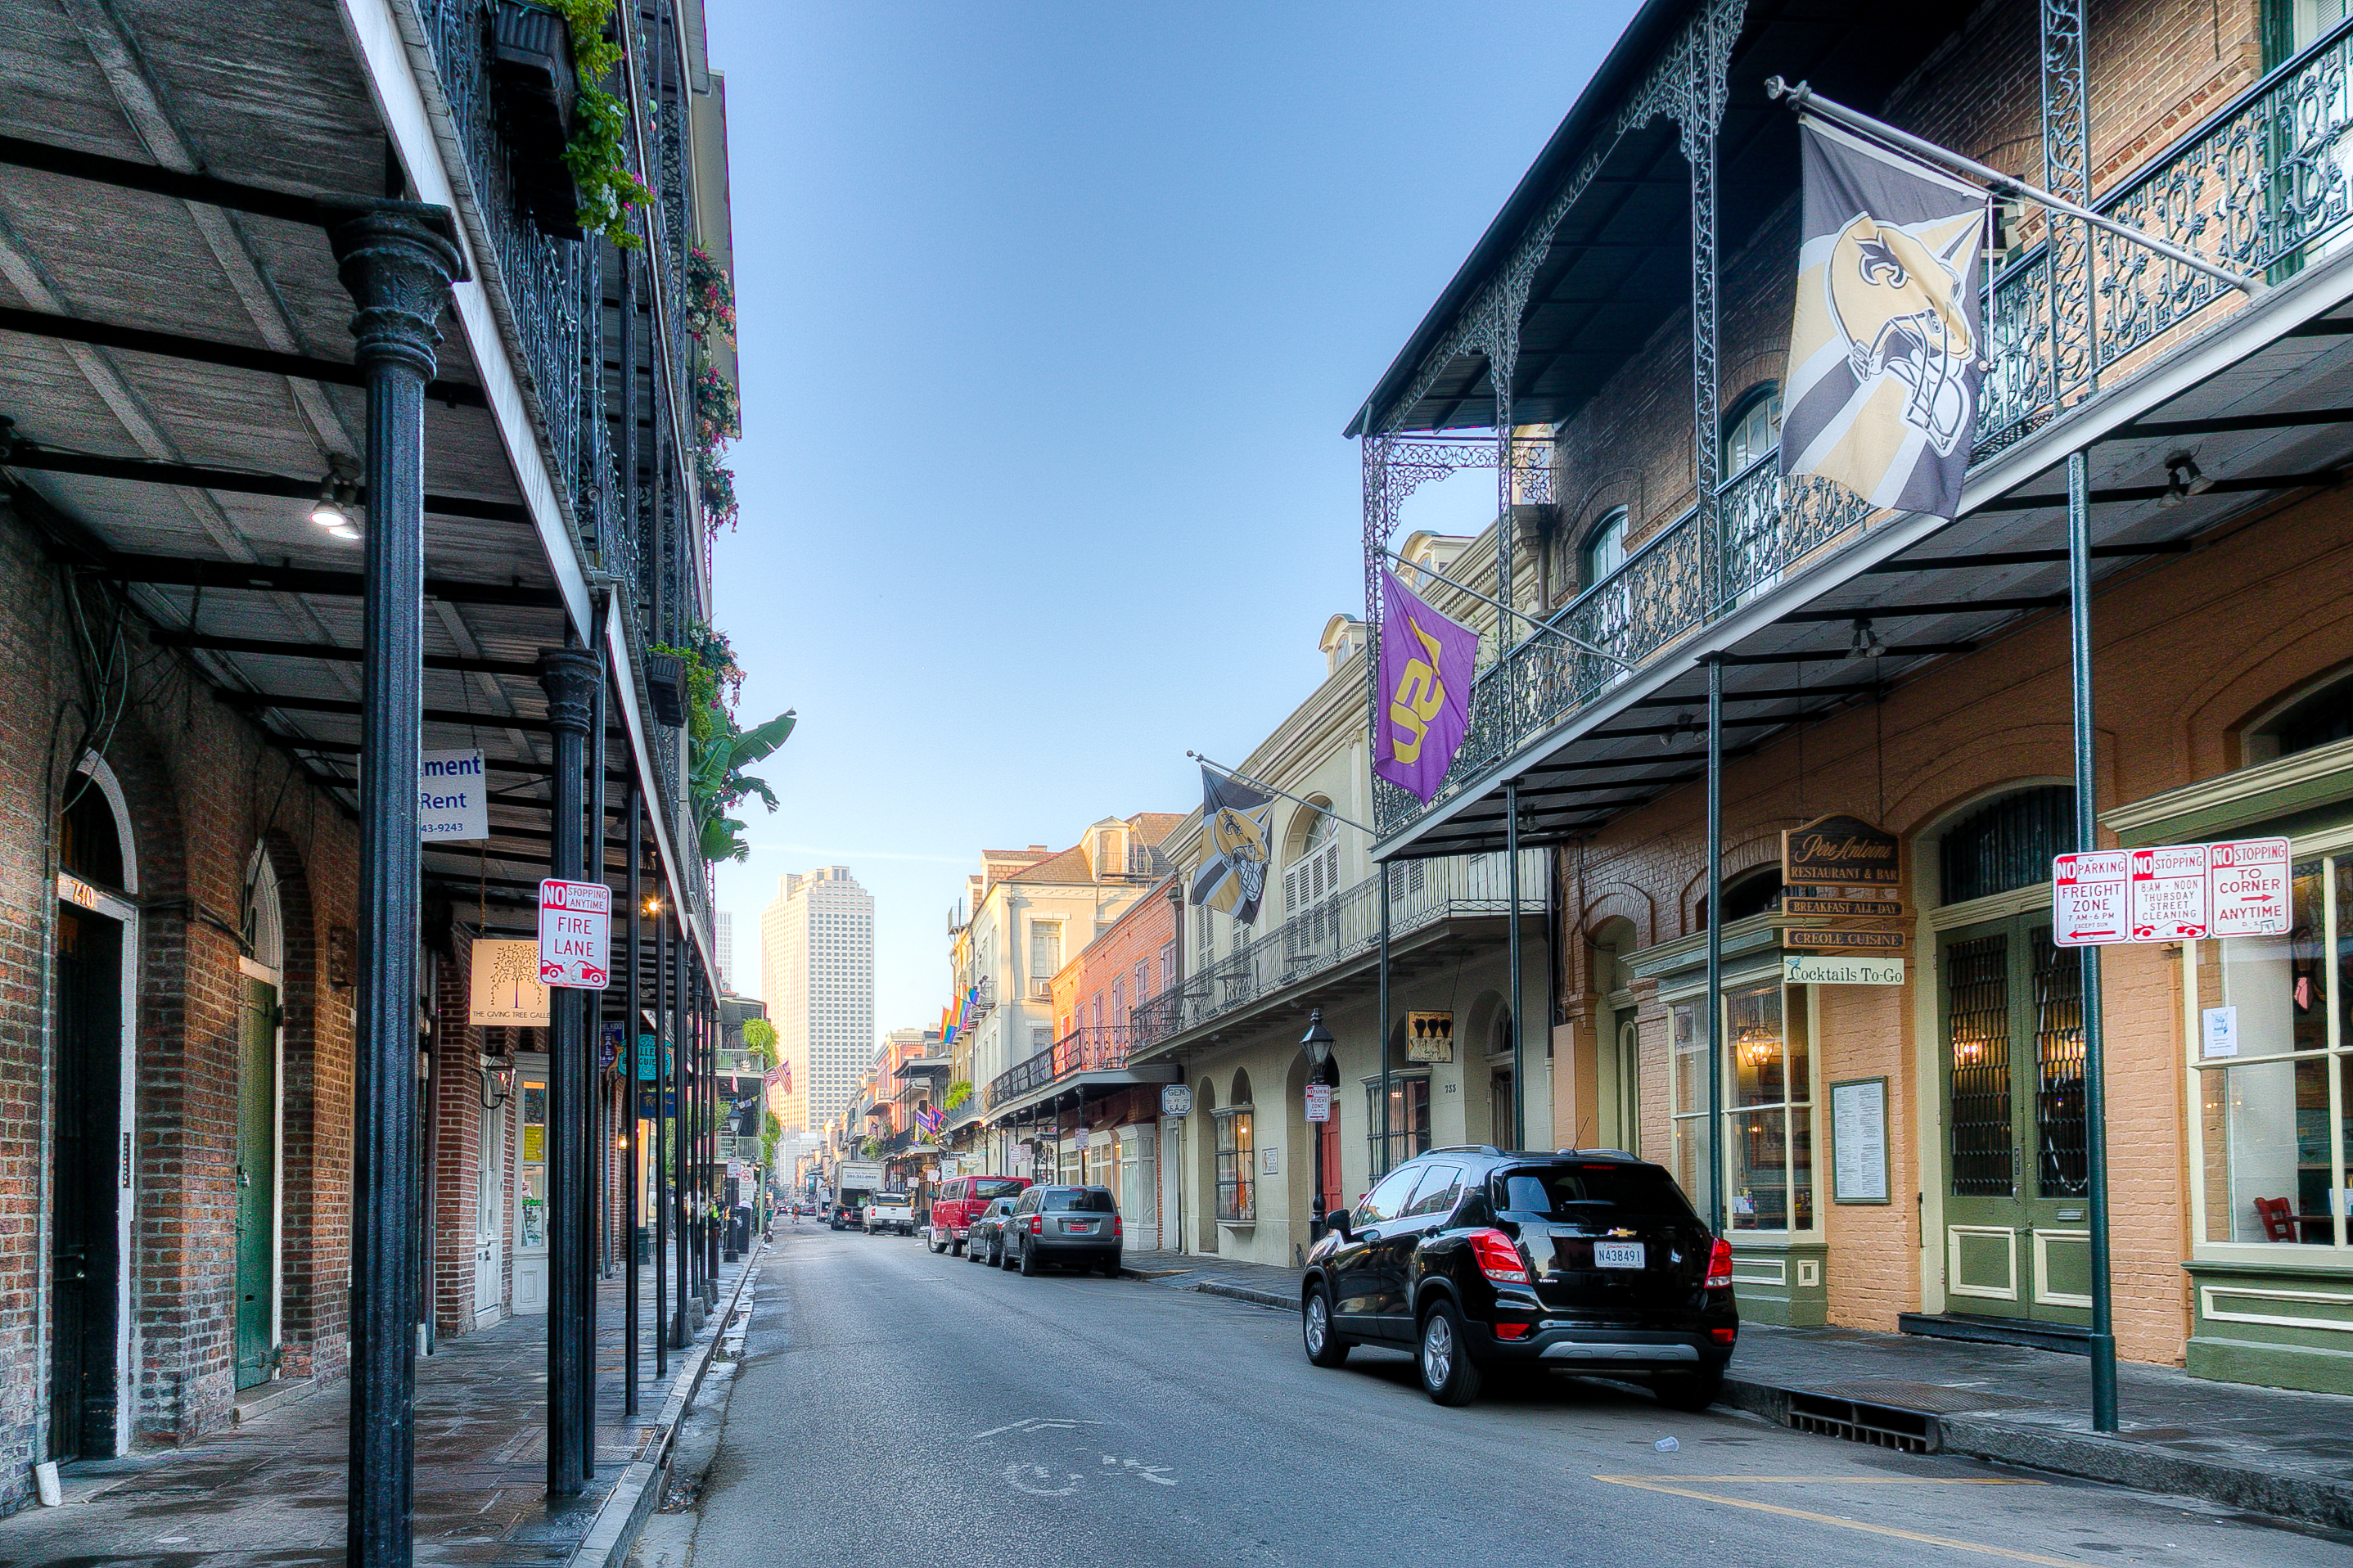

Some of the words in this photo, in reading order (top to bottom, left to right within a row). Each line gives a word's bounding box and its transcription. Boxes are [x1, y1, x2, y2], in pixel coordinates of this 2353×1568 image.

[422, 756, 481, 776] ment
[421, 792, 467, 809] Rent
[1830, 837, 1892, 860] Antoine
[2213, 847, 2234, 866] NO
[2235, 845, 2285, 861] STOPPING
[1792, 867, 1860, 878] RESTAURANT
[1865, 869, 1872, 879] &
[1877, 870, 1896, 880] BAR
[2057, 862, 2076, 880] NO
[2078, 861, 2125, 875] PARKING
[2133, 856, 2153, 875] NO
[2155, 856, 2202, 869] STOPPING
[2238, 868, 2261, 880] TO
[2062, 884, 2121, 899] FREIGHT
[2174, 880, 2198, 890] NOON
[2220, 878, 2280, 894] CORNER
[71, 880, 94, 908] 740
[543, 885, 566, 906] NO
[568, 887, 606, 899] STOPPING
[2144, 891, 2194, 902] THURSDAY
[570, 899, 604, 910] ANYTIME
[1794, 902, 1851, 913] BREAKFAST
[1855, 903, 1873, 913] ALL
[1878, 904, 1896, 914] DAY
[2073, 899, 2110, 912] ZONE
[2150, 901, 2188, 911] STREET
[2143, 910, 2197, 920] CLEANING
[2219, 905, 2282, 921] ANYTIME
[558, 917, 592, 935] FIRE
[555, 939, 594, 957] LANE
[1795, 934, 1842, 944] CREOLE
[1848, 935, 1899, 946] CUISINE
[1789, 966, 1857, 982] Cocktails
[1860, 968, 1902, 982] To-Go
[1599, 1250, 1640, 1262] N438491
